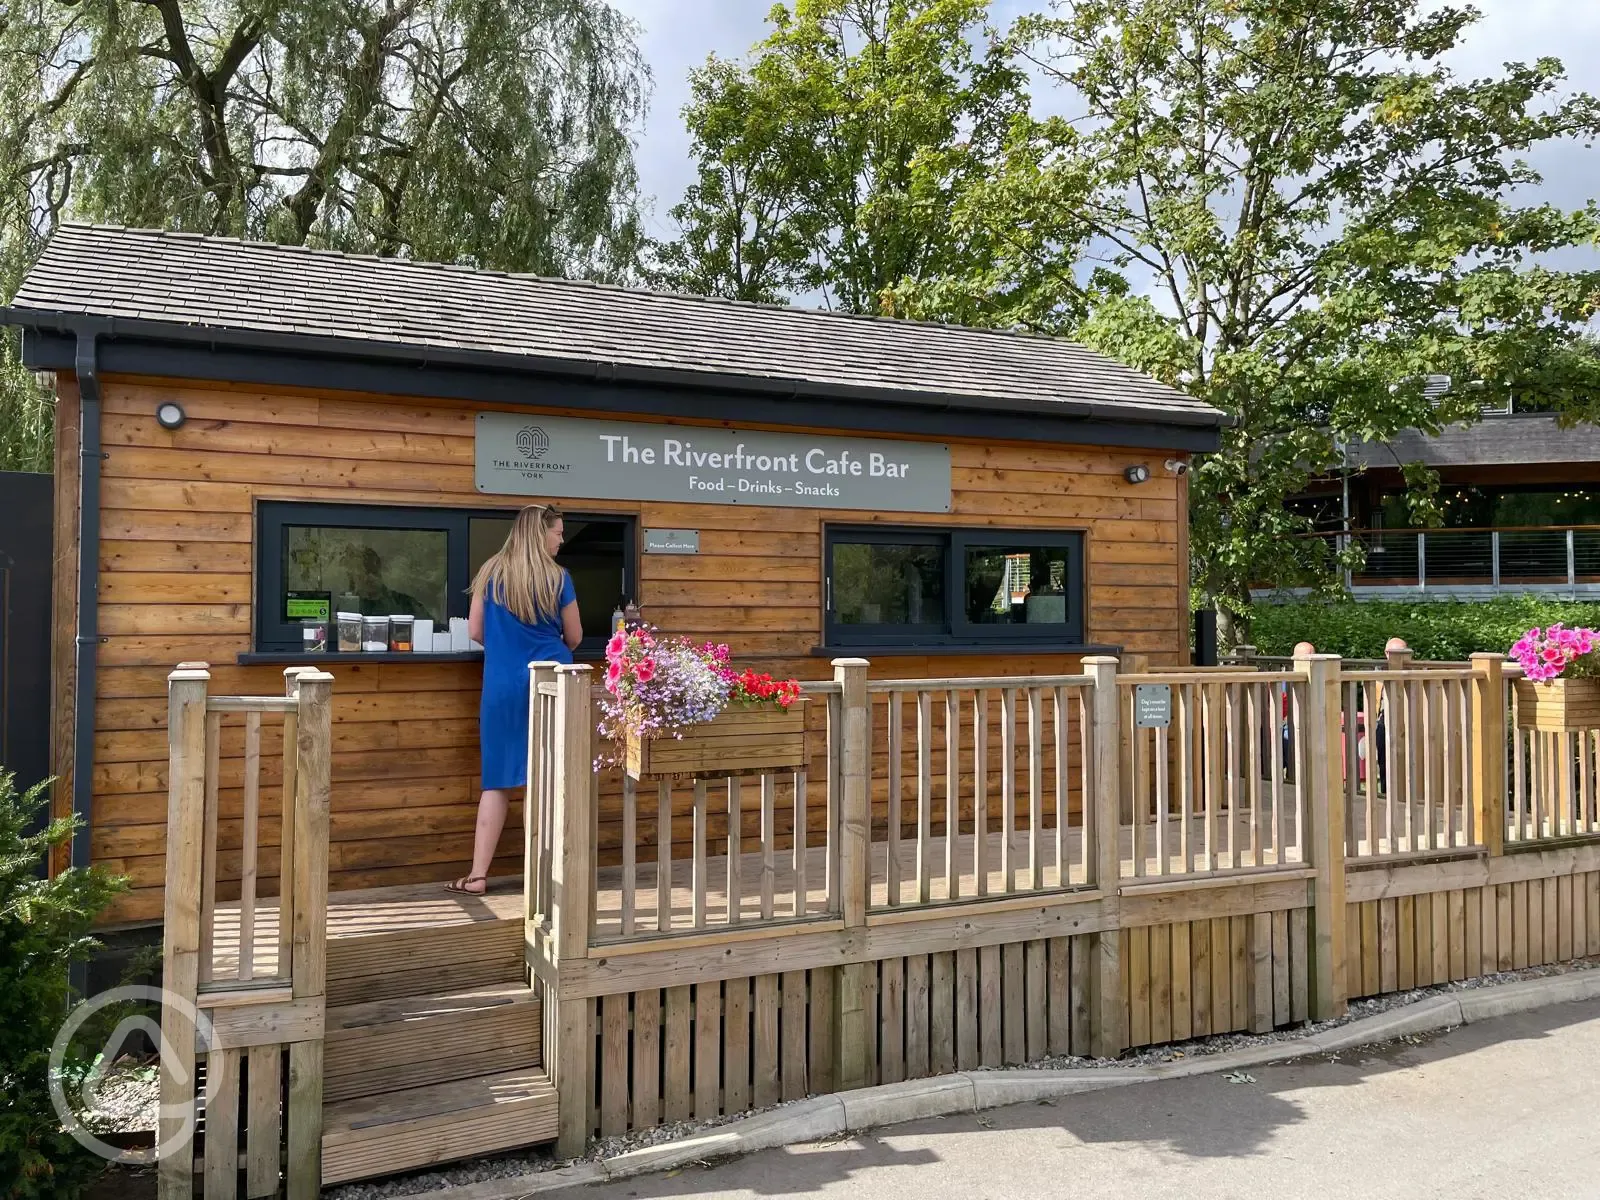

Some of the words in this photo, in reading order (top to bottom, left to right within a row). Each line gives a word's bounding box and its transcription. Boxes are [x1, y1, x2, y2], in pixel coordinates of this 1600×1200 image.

[514, 461, 571, 470] RIVERFRONT
[600, 434, 656, 465] The
[664, 439, 799, 473] Riverfront
[805, 448, 863, 476] Cafe
[869, 452, 909, 478] Bar
[689, 475, 724, 491] Food
[738, 478, 782, 494] Drinks
[795, 481, 840, 497] Snacks
